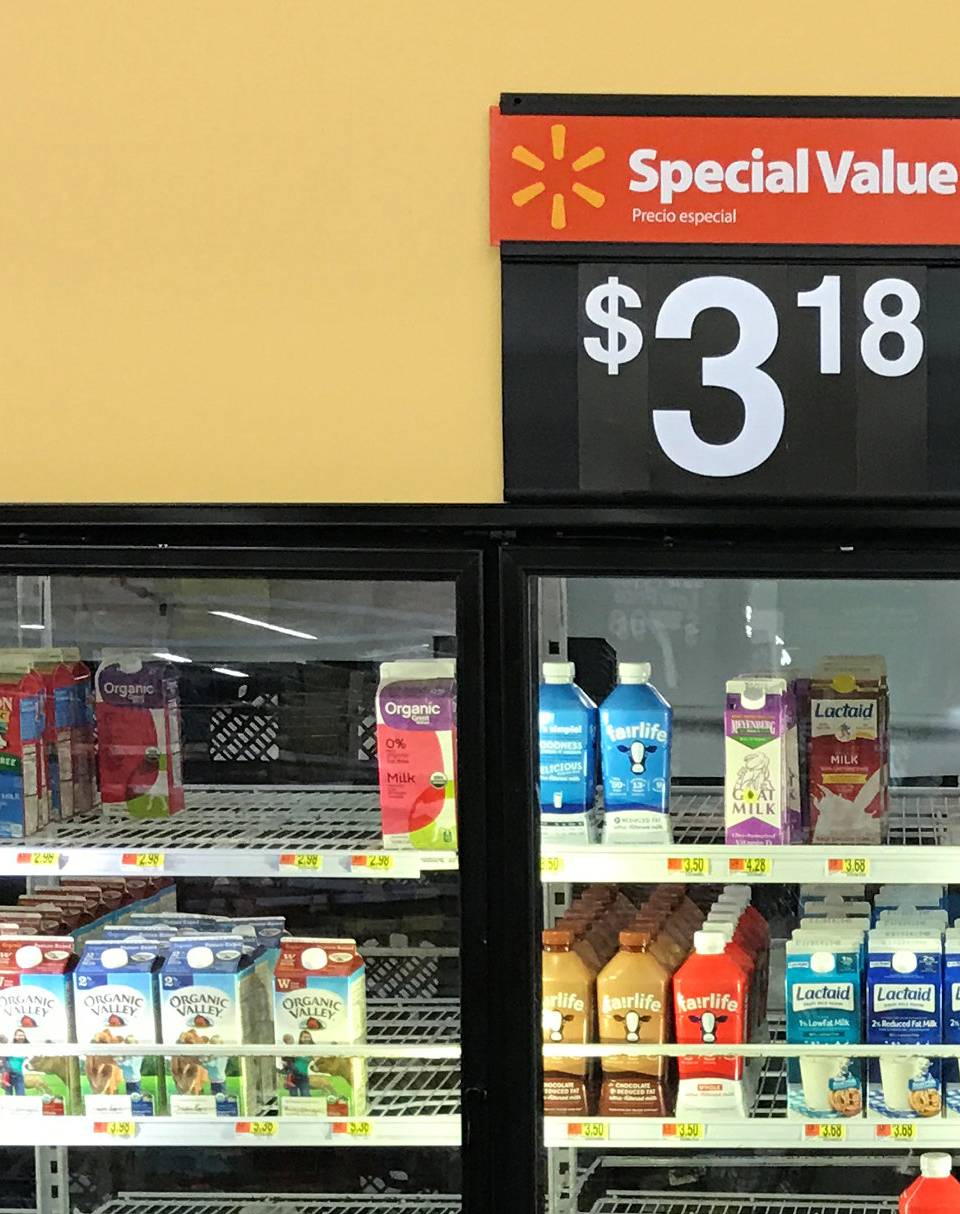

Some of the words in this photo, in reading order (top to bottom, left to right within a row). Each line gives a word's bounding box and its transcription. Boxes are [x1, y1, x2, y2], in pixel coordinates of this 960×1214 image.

[628, 148, 809, 204] Special
[816, 150, 959, 196] Value
[632, 208, 677, 225] Precio
[679, 208, 737, 227] especial
[103, 682, 155, 698] Organic
[384, 701, 441, 719] Organic
[814, 702, 874, 718] Lactaid
[604, 721, 668, 744] fairlife
[385, 738, 407, 749] 0%
[830, 755, 859, 765] MILK
[387, 772, 417, 784] Milk
[732, 803, 776, 815] MILK
[684, 859, 704, 872] 3.50
[746, 858, 766, 871] 4.28
[845, 858, 866, 872] 3.68
[795, 985, 851, 1001] Lactaid
[877, 986, 932, 1002] Lactaid
[84, 993, 144, 1009] ORGANIC
[169, 993, 230, 1009] ORGANIC
[282, 996, 342, 1011] ORGANIC
[602, 992, 663, 1013] fairlife
[676, 992, 739, 1013] fairlife
[90, 1005, 138, 1017] VALLEY
[176, 1005, 223, 1018] VALLEY
[288, 1007, 337, 1021] VALLEY
[881, 1019, 911, 1028] Reduced
[912, 1019, 922, 1028] Fat
[922, 1018, 938, 1028] Milk
[585, 1122, 604, 1136] 3.50
[679, 1122, 699, 1136] 3.50
[822, 1124, 842, 1136] 3.68
[893, 1124, 913, 1136] 3.68
